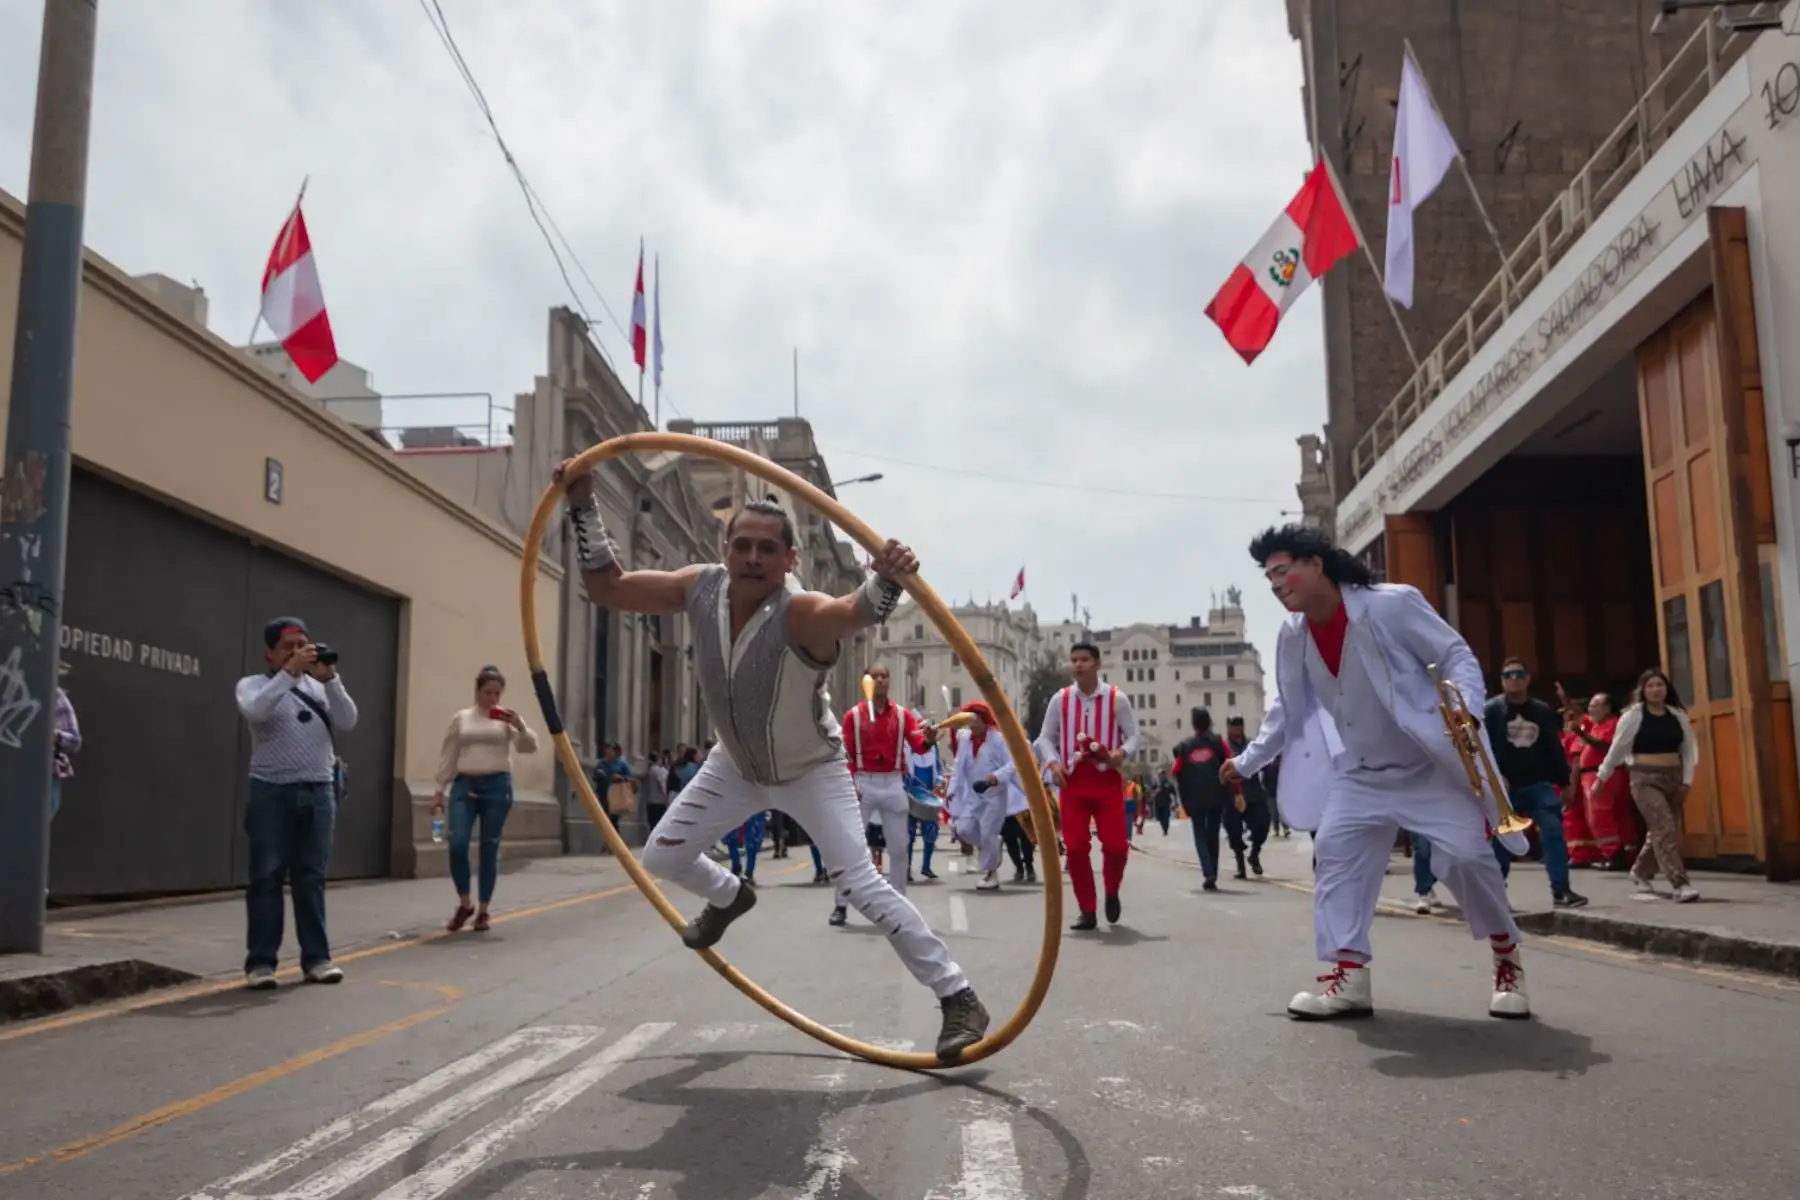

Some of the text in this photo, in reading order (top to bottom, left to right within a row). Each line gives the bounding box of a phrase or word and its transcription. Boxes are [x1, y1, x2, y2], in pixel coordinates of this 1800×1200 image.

[1537, 213, 1662, 354] SALVADORA
[1671, 128, 1748, 219] LIMA
[59, 625, 201, 678] OPIEDAD PRIVADA
